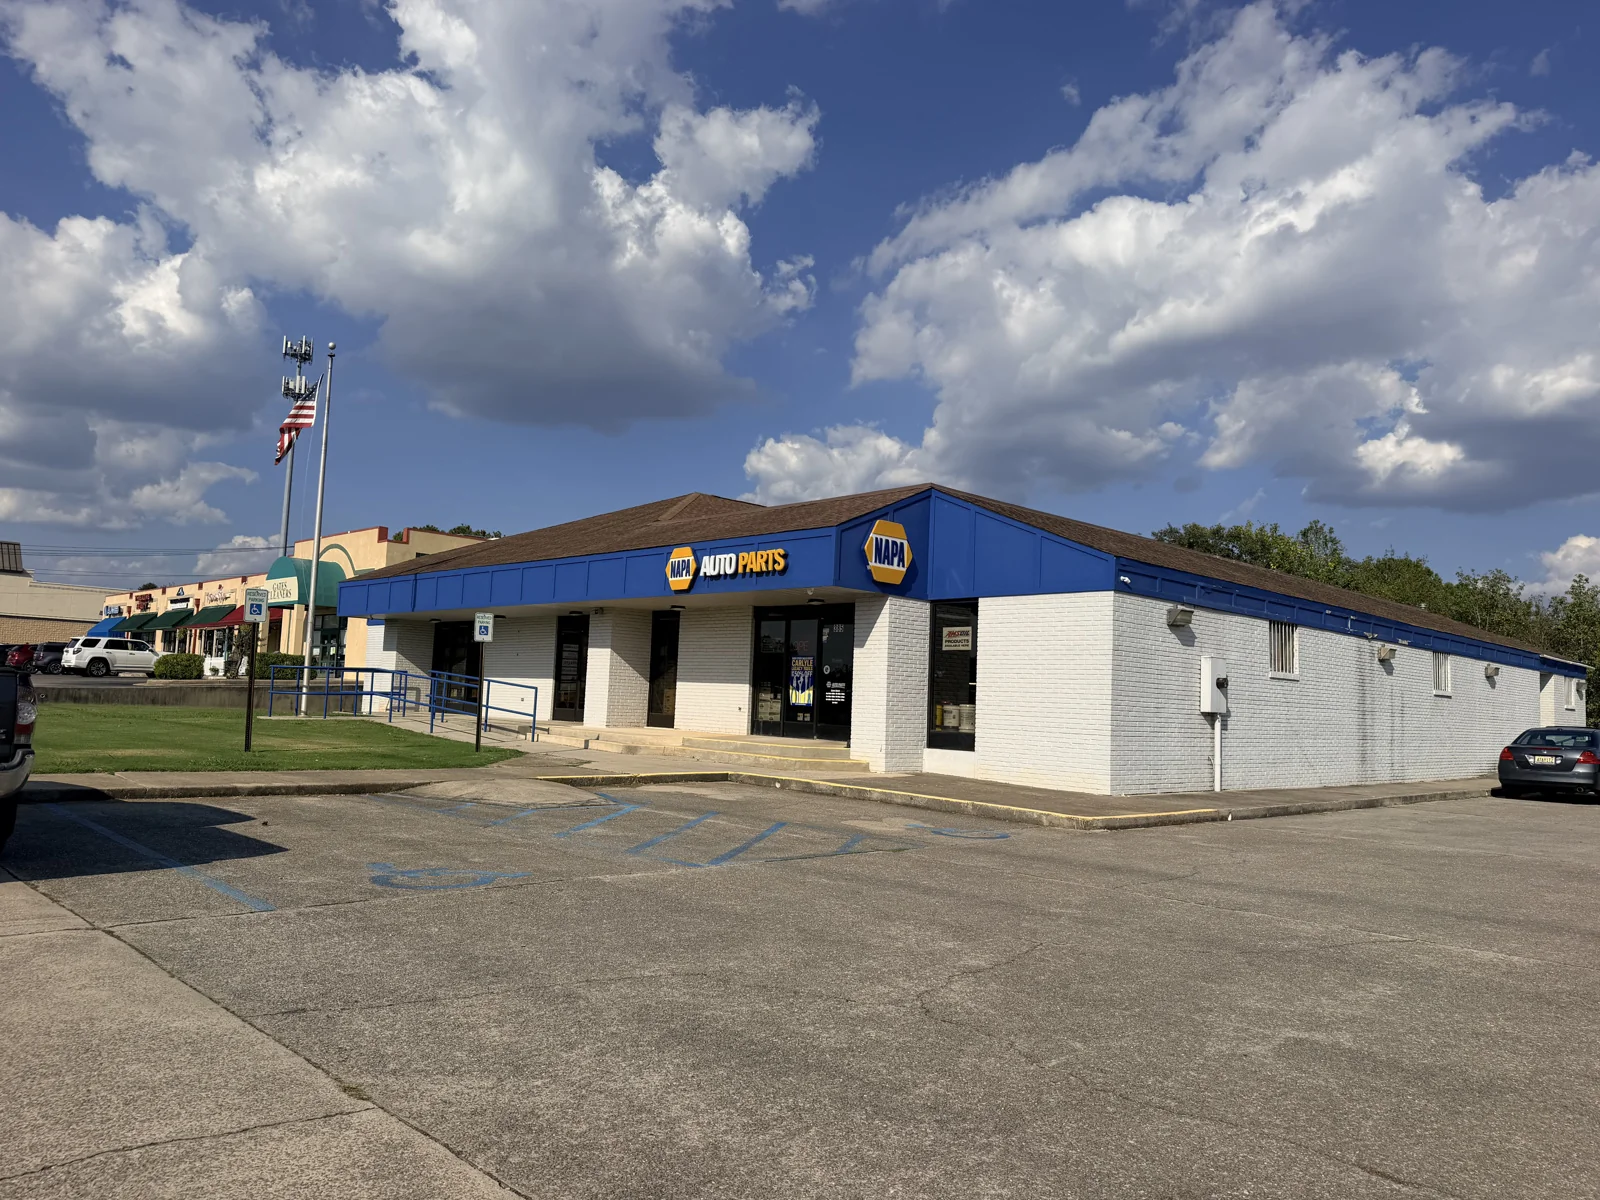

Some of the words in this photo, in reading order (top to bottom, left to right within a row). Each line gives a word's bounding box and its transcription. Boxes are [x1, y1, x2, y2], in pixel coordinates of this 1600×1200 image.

[875, 536, 906, 569] NAPA
[670, 558, 691, 578] NAPA
[700, 553, 737, 576] AUTO
[738, 548, 786, 574] PARTS
[272, 581, 288, 591] GATES
[268, 589, 292, 600] LEANERS
[791, 659, 814, 667] CARLYLE
